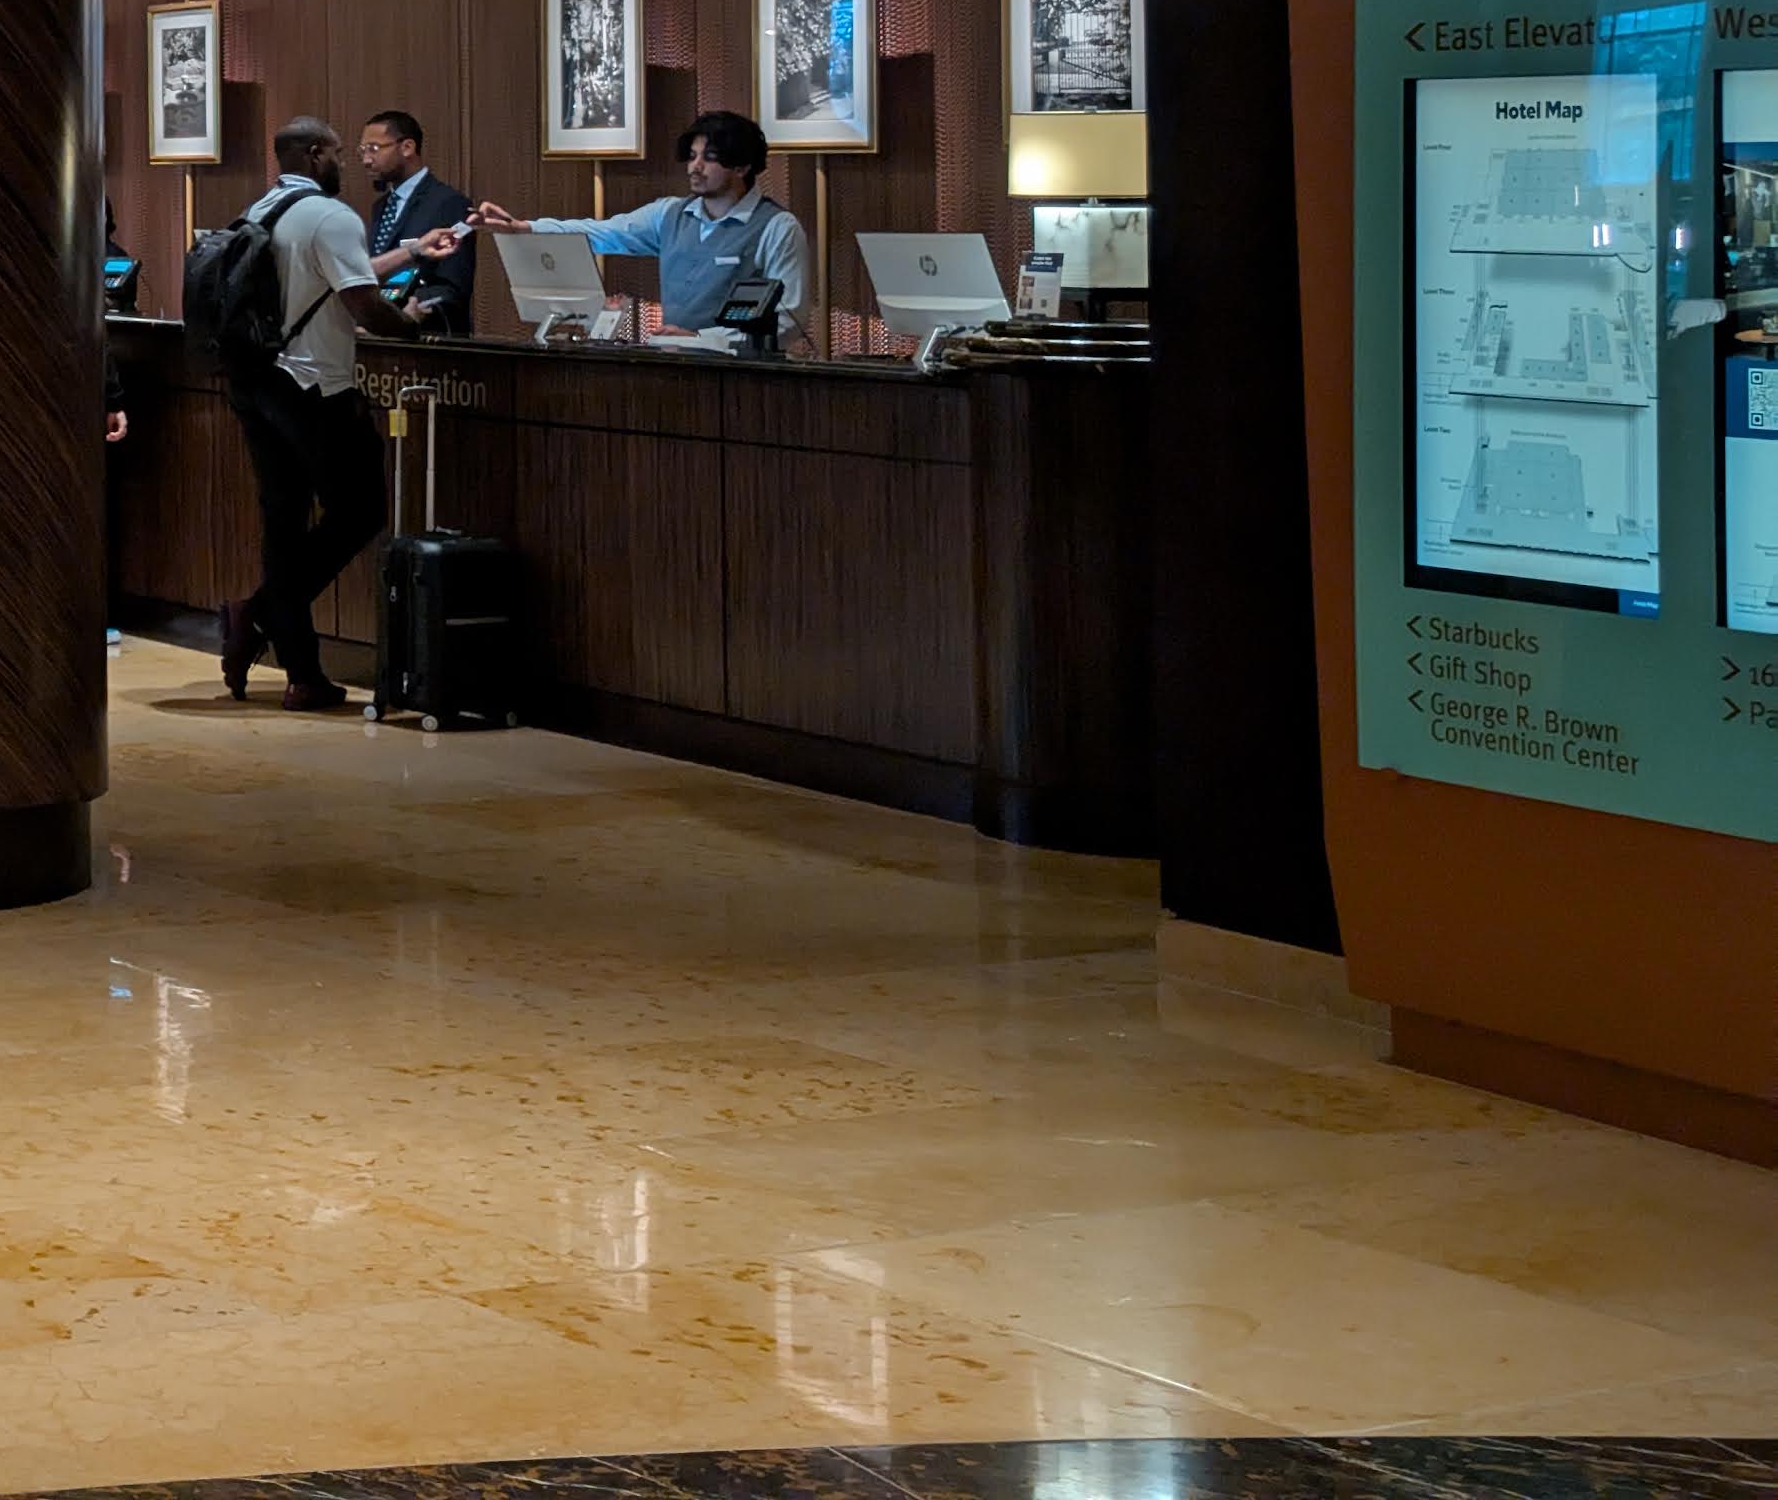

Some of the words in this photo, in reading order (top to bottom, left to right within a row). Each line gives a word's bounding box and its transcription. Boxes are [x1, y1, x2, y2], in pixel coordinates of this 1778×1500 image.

[1435, 21, 1494, 51] East
[1505, 16, 1611, 49] Elevat
[1496, 101, 1541, 119] Hotel
[1546, 101, 1583, 123] Map
[355, 363, 487, 407] Registration
[1429, 617, 1540, 654] Starbucks
[1430, 654, 1467, 682] Gift
[1475, 661, 1532, 696] Shop
[1430, 692, 1508, 729] George
[1516, 705, 1537, 731] R.
[1546, 709, 1619, 744] Brown
[1431, 719, 1555, 761] Convention
[1563, 740, 1640, 776] Center
